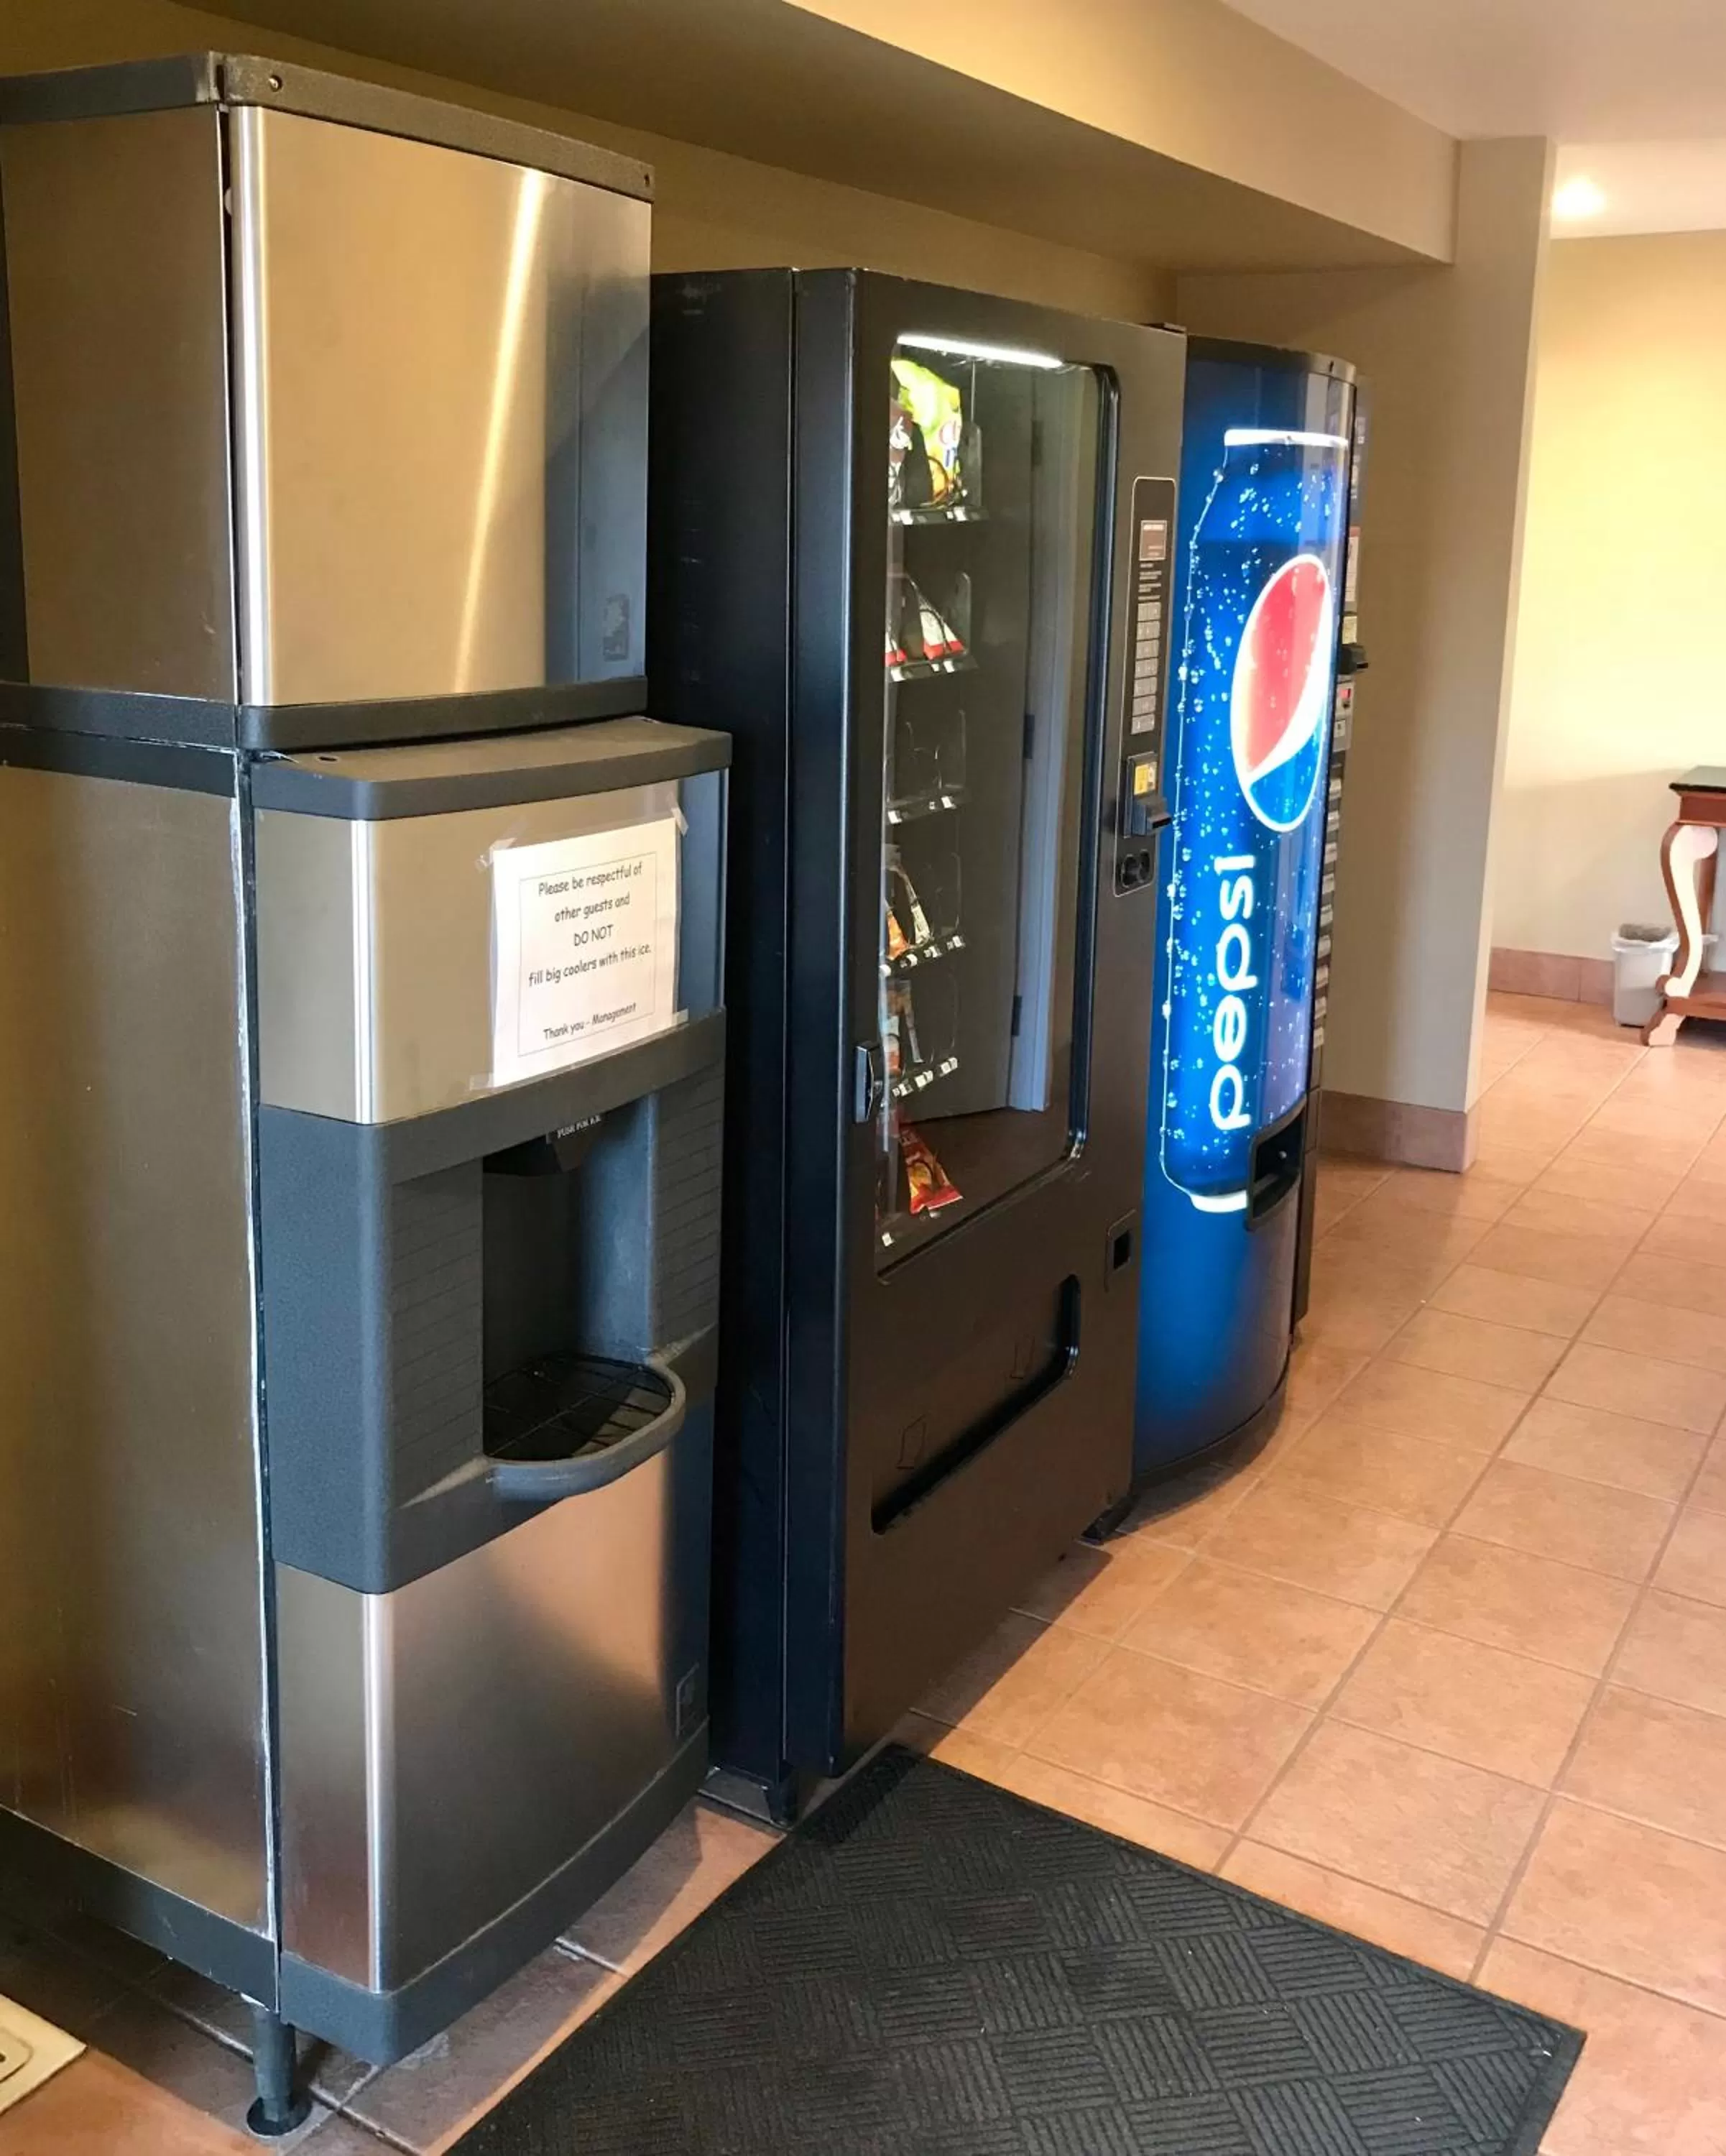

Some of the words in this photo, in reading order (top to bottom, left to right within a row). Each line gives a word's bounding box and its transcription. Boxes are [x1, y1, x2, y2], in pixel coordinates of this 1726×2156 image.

[538, 881, 569, 897] Please
[572, 876, 584, 889] be
[586, 865, 632, 886] respectful
[633, 861, 643, 875] of
[555, 906, 581, 922] other
[583, 899, 613, 919] guests
[614, 891, 630, 908] and
[573, 931, 589, 946] DO
[591, 924, 614, 941] NOT
[528, 969, 544, 987] fill
[545, 967, 561, 984] big
[563, 959, 597, 977] coolers
[599, 952, 618, 968] with
[620, 947, 636, 962] this
[637, 944, 652, 955] ice.
[543, 1023, 569, 1041] Thank
[570, 1022, 584, 1036] you
[592, 1002, 637, 1026] Management
